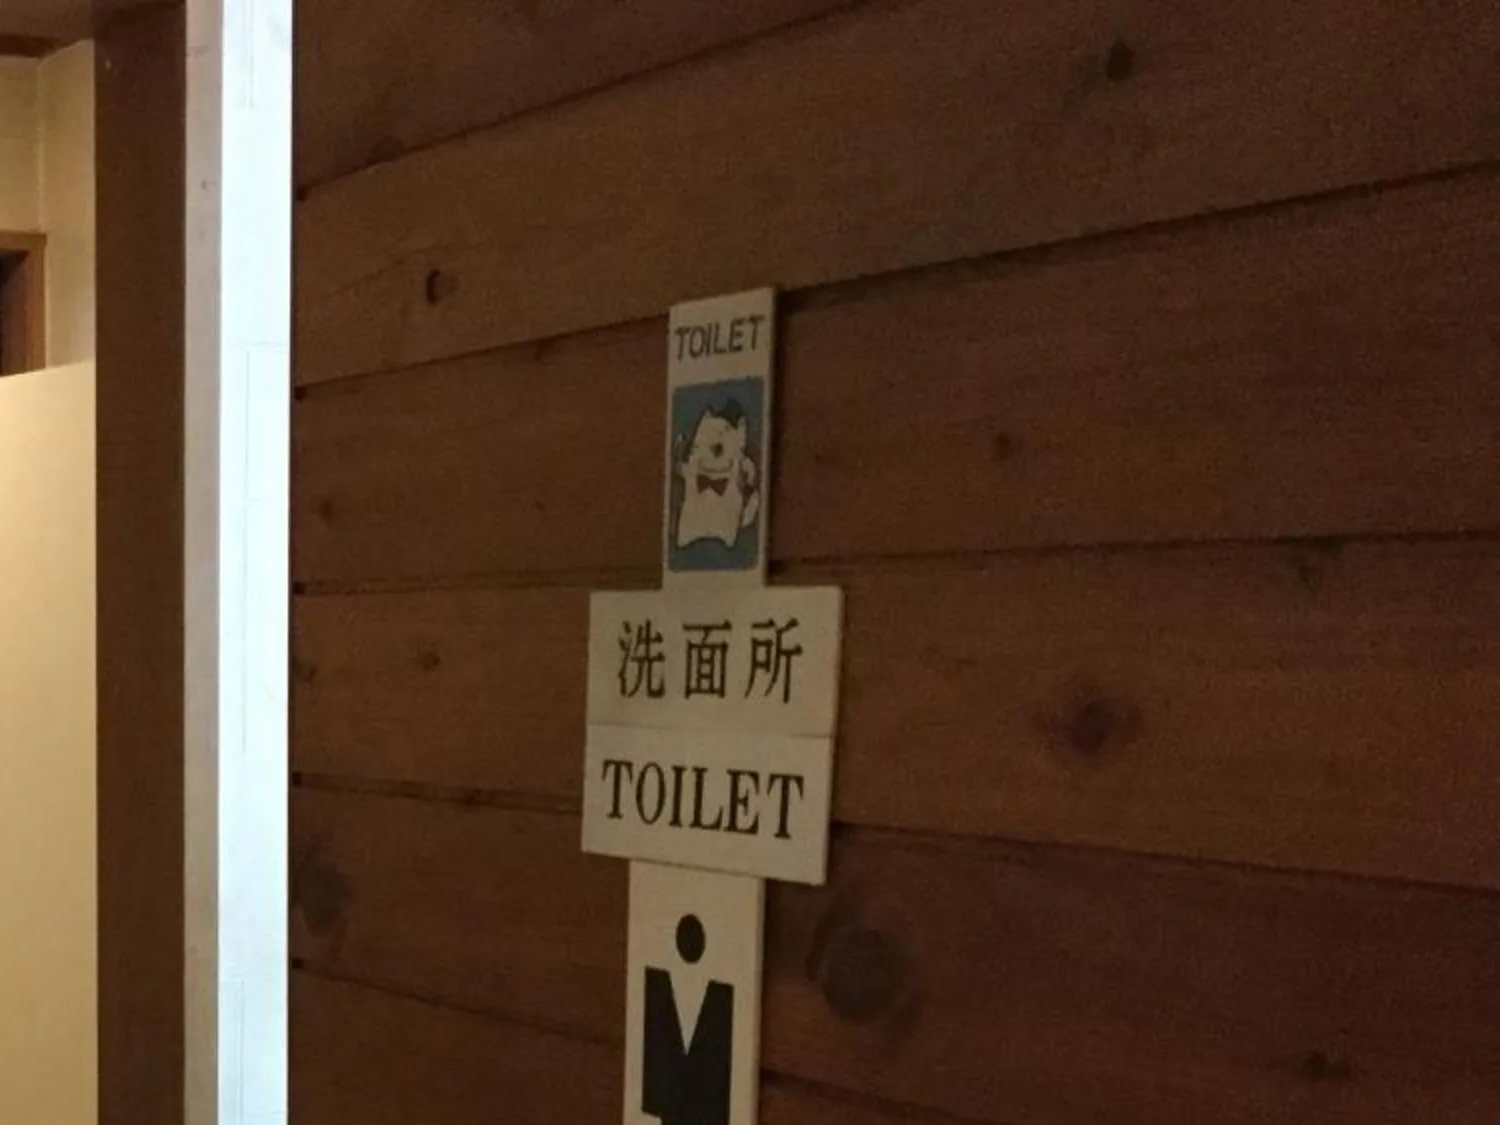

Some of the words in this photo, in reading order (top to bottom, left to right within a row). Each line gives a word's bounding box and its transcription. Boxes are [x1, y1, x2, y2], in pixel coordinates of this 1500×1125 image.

[674, 315, 765, 363] TOILET
[617, 617, 804, 705] 洗面所
[601, 758, 805, 840] TOILET
